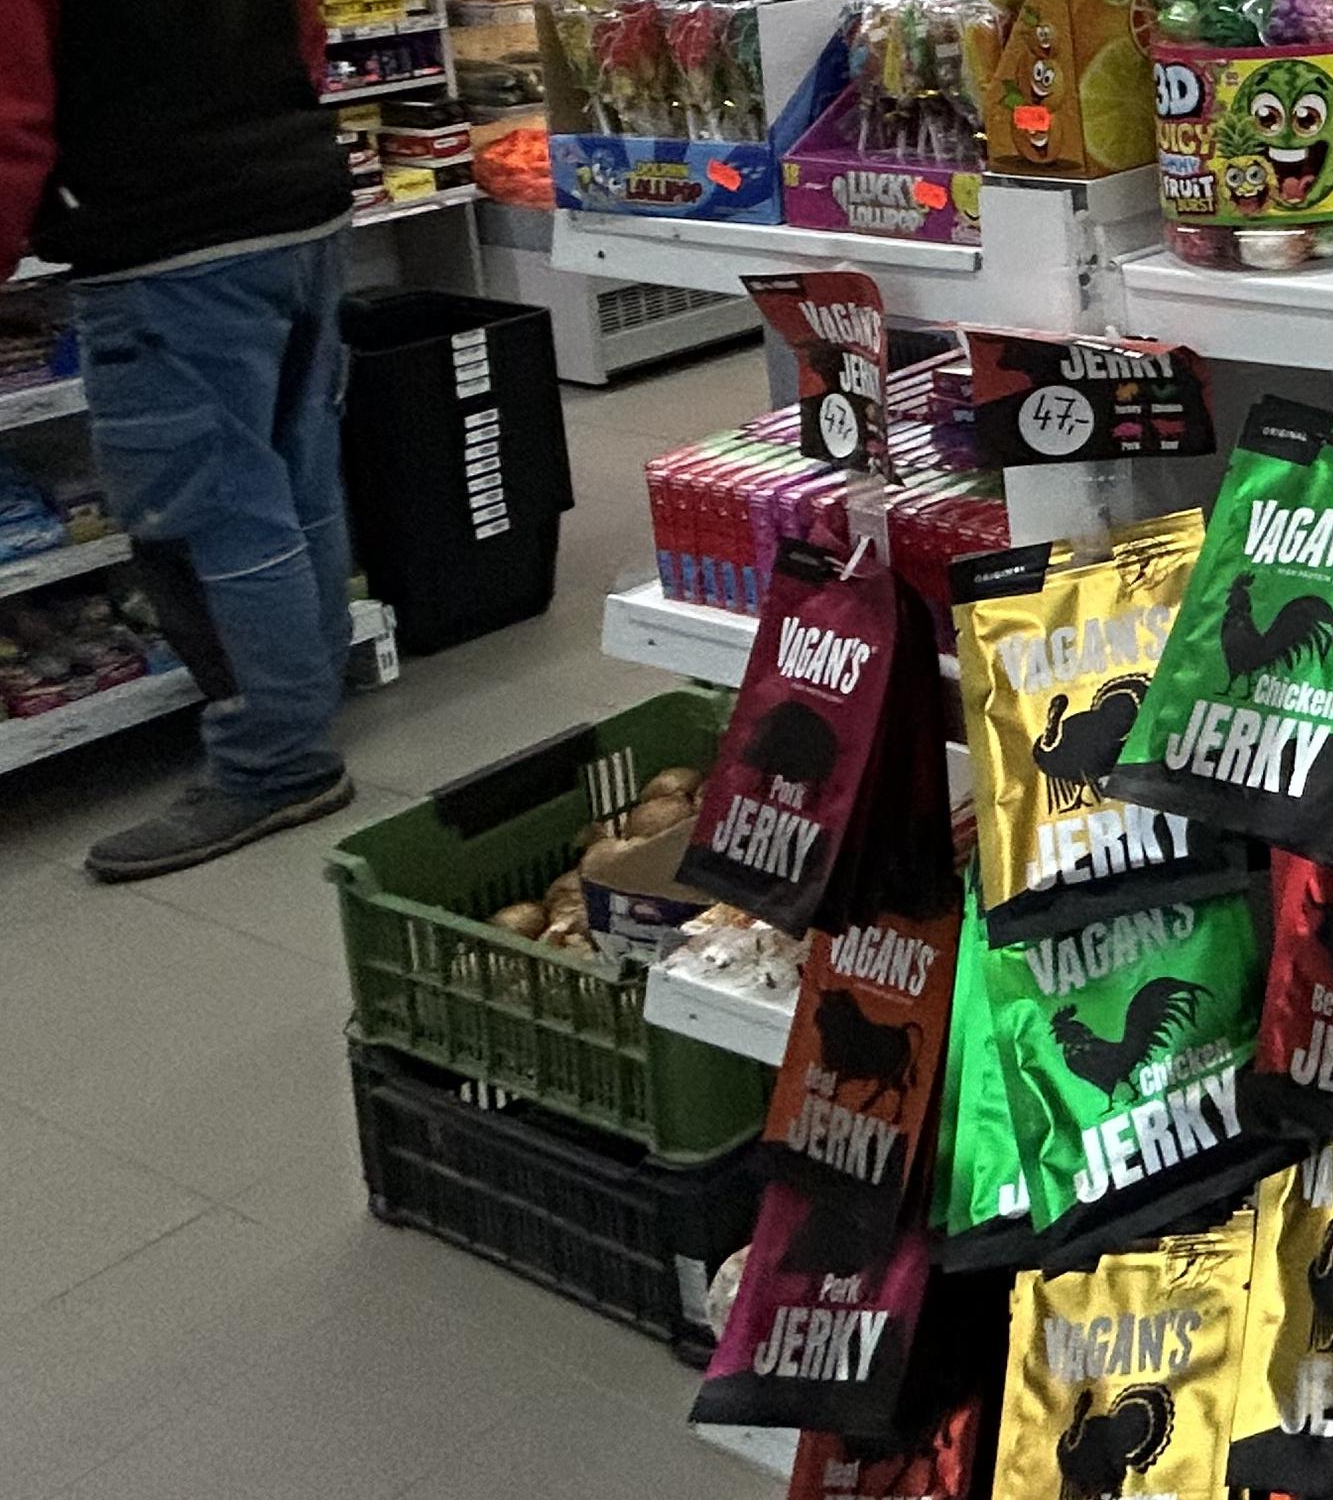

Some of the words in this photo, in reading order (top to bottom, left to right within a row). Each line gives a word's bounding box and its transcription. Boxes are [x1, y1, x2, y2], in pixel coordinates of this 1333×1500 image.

[1154, 63, 1200, 116] 3D
[1158, 122, 1213, 155] UICY
[777, 616, 872, 694] VAGAN'S
[998, 604, 1172, 695] VAGAN'S
[1164, 700, 1332, 799] JERKY
[770, 774, 809, 811] Pork
[712, 795, 821, 884] JERKY
[1026, 803, 1190, 892] JERKY
[787, 1099, 900, 1186] JERKY
[1073, 1066, 1242, 1202] JERKY
[819, 1272, 861, 1304] Pork
[752, 1306, 888, 1382] JERKY
[1044, 1308, 1202, 1383] VAGAN'S
